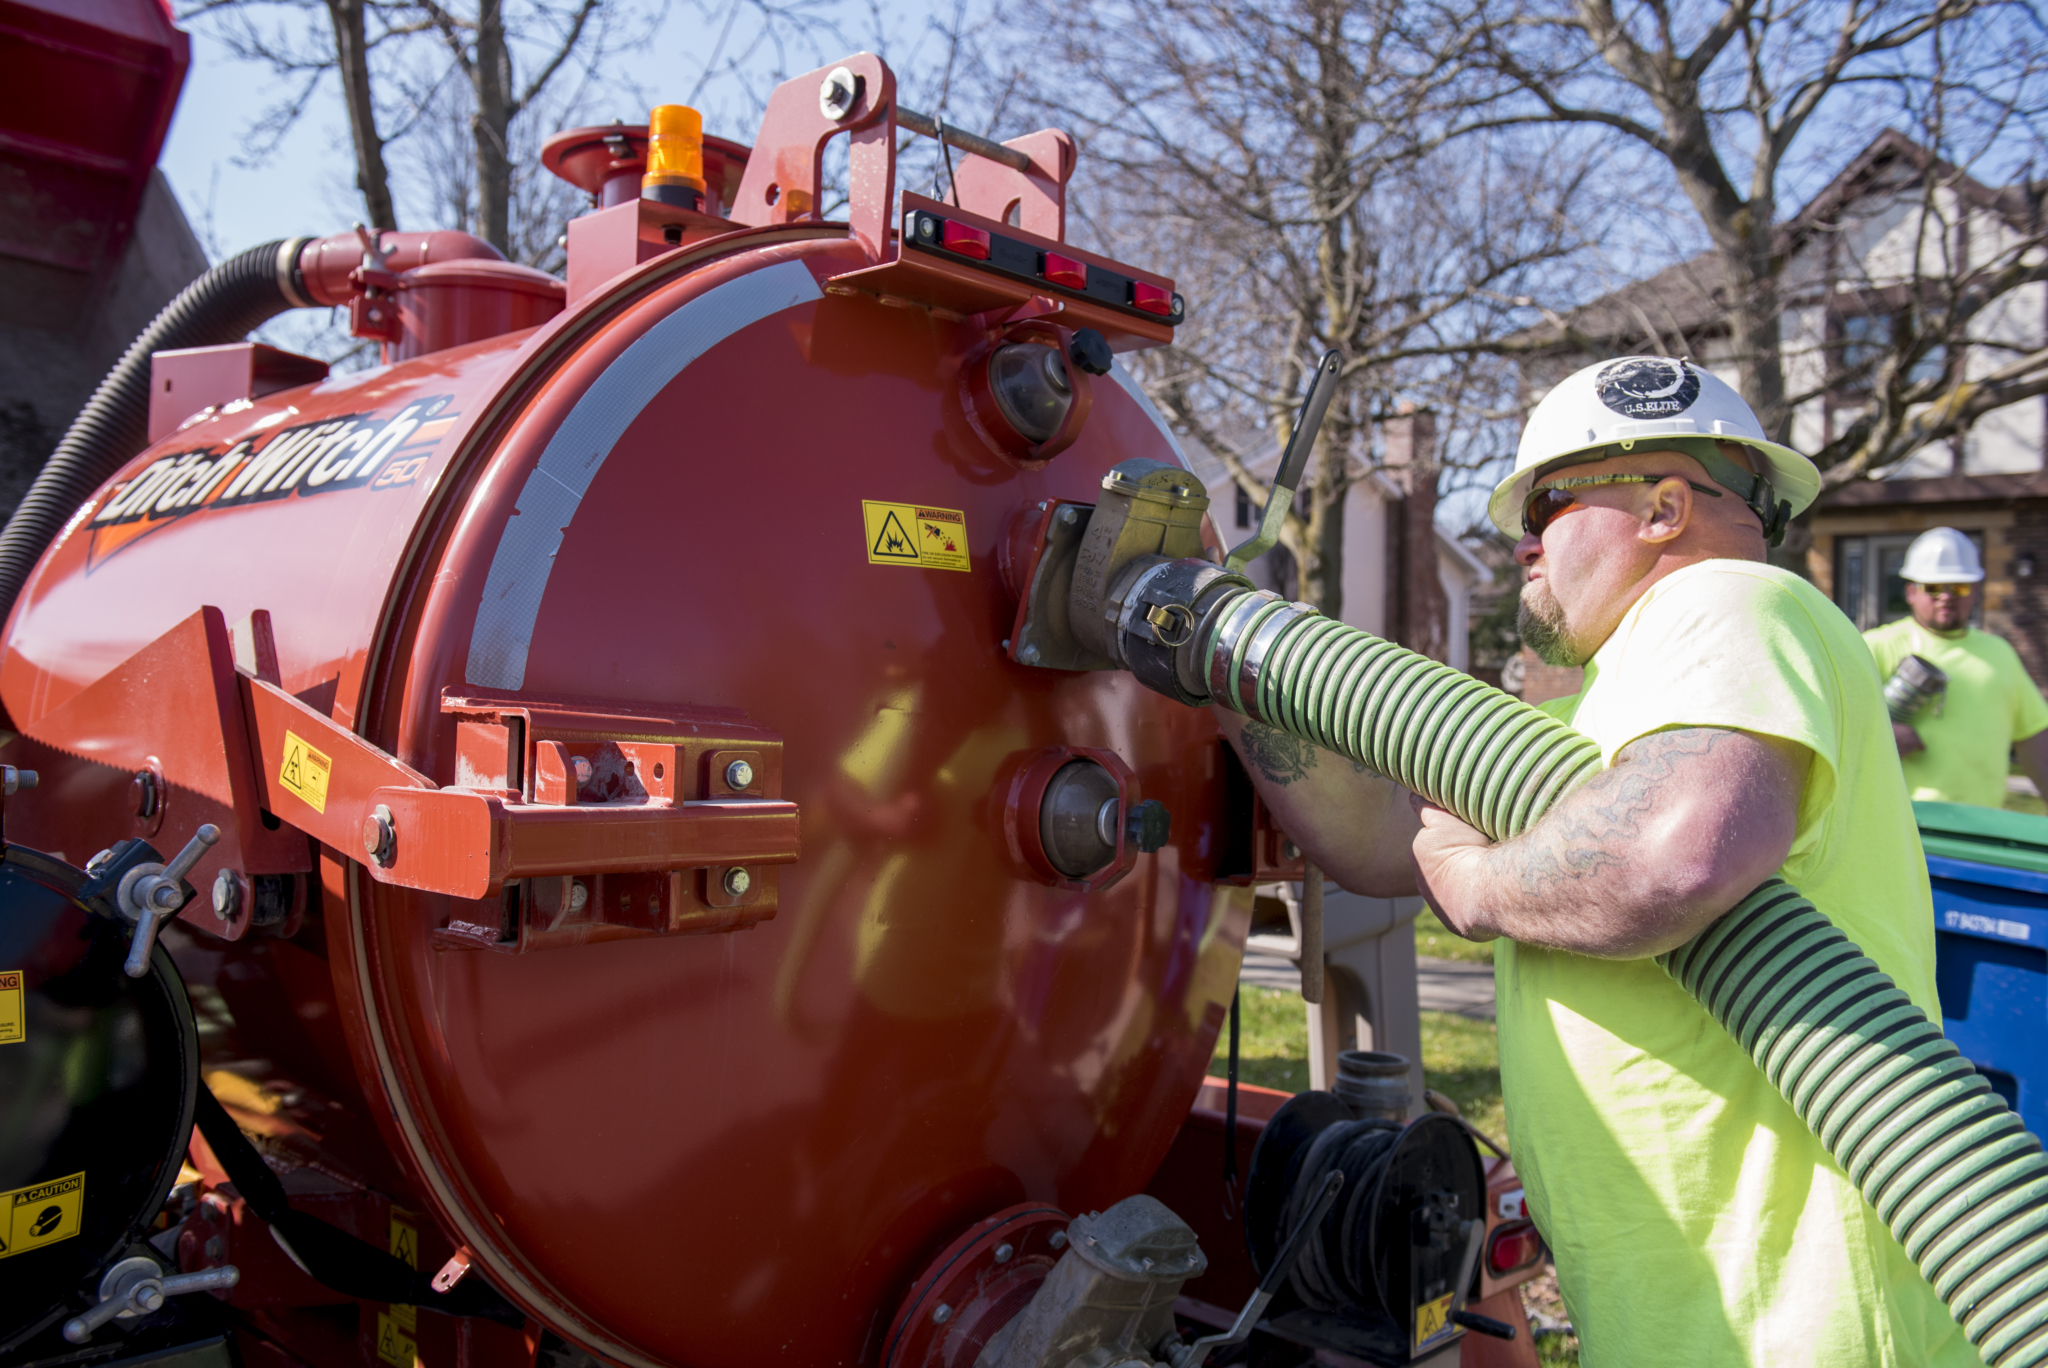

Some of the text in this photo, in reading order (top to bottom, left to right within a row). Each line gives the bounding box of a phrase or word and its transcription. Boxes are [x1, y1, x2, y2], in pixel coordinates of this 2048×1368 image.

[221, 404, 422, 500] Witch
[925, 510, 961, 521] WARNING
[29, 1178, 79, 1201] CAUTION
